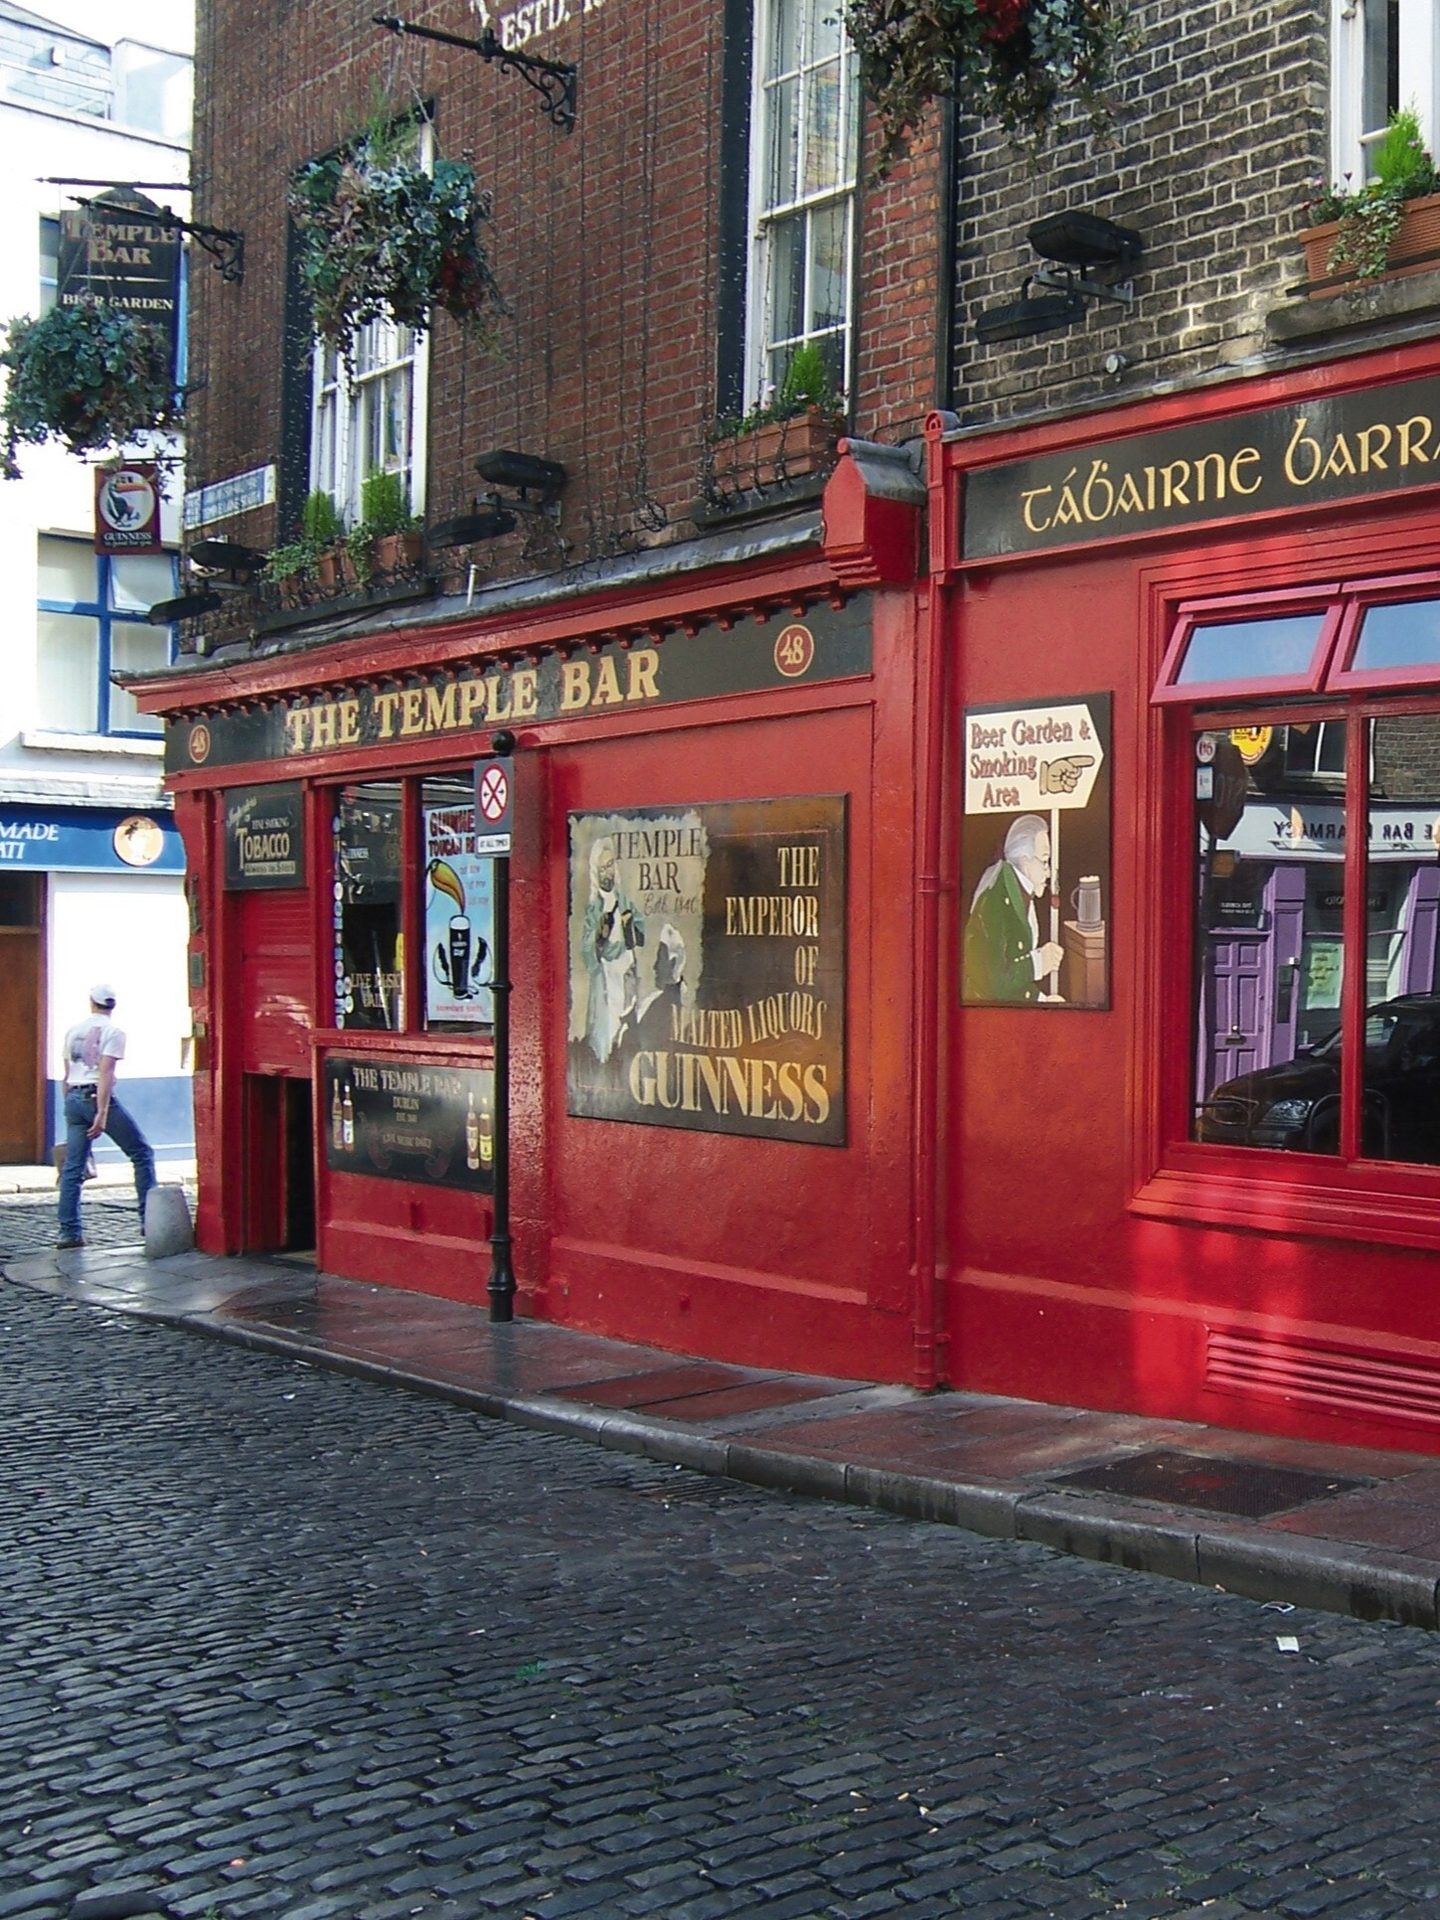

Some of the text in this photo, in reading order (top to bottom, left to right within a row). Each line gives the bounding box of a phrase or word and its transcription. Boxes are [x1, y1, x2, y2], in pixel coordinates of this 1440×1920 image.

[64, 217, 179, 244] TEMPLE
[87, 239, 151, 264] BAR
[63, 293, 173, 310] BER GARDEN
[104, 531, 152, 541] GUINNESS
[780, 636, 806, 666] 48
[288, 648, 661, 750] THE TEMPLE BAR
[970, 717, 1092, 750] Beer Garden &
[970, 750, 1038, 780] Smoking
[982, 782, 1021, 808] Area
[430, 809, 475, 837] GUINNE
[235, 828, 290, 871] TOBACCO
[612, 827, 703, 860] TEMPLE
[638, 860, 681, 894] BAR
[778, 846, 820, 888] THE
[725, 895, 820, 937] EMPEROR
[351, 972, 372, 988] LIVE
[794, 946, 820, 986] OF
[671, 991, 828, 1049] MALTED LIQUORS
[353, 1067, 461, 1096] THE TEMPLE BAR
[629, 1051, 831, 1124] GUINNESS
[393, 1096, 420, 1110] DUBLIN
